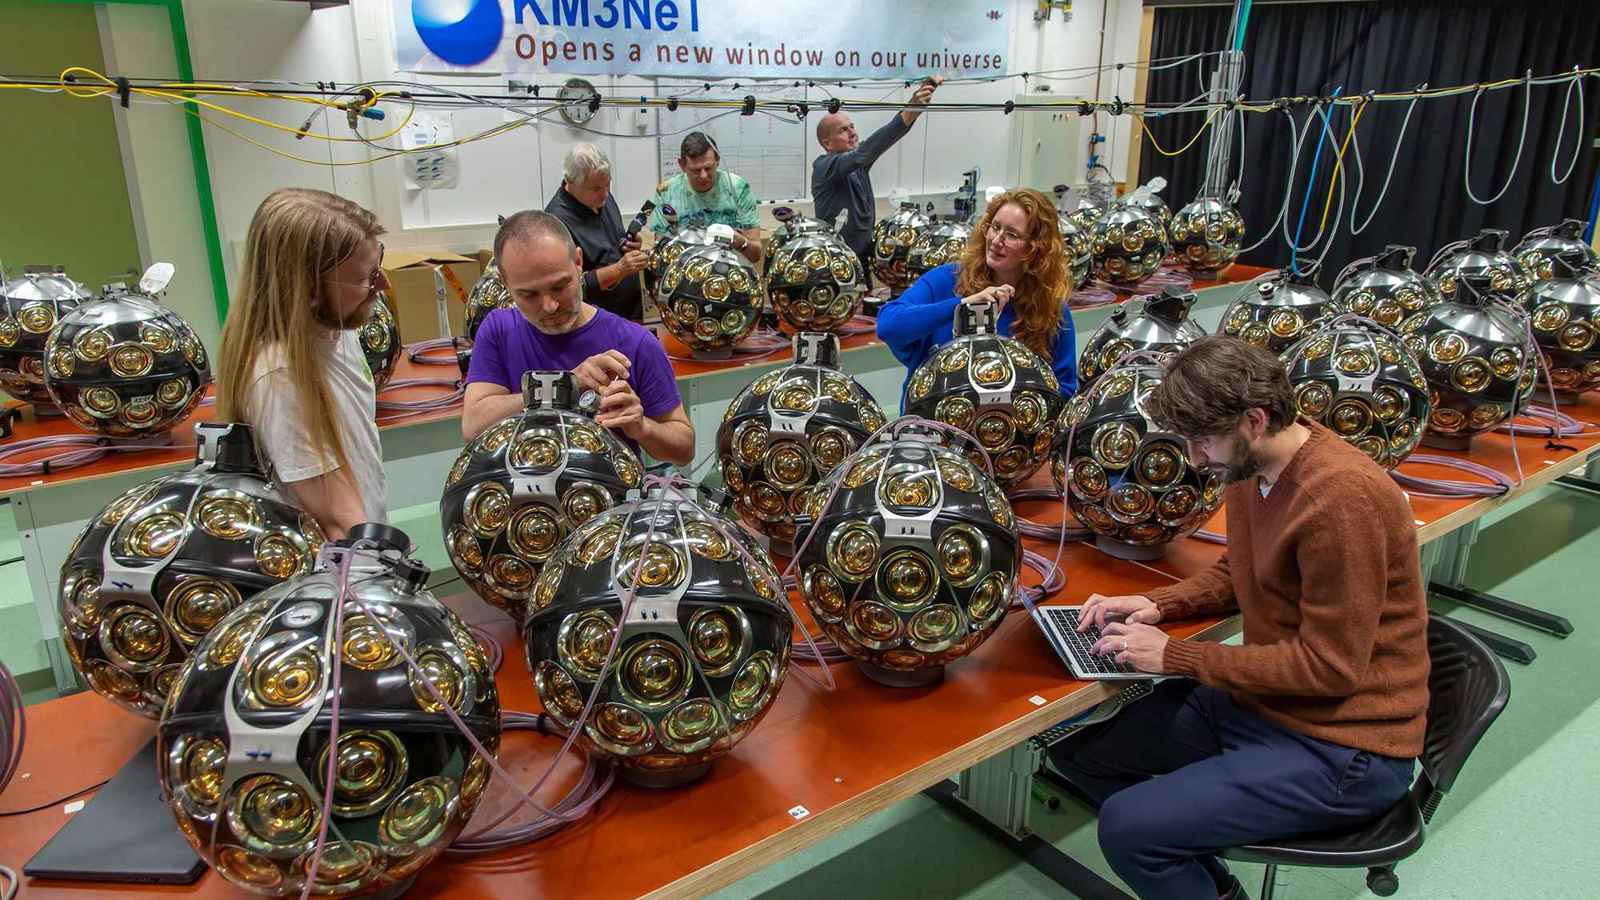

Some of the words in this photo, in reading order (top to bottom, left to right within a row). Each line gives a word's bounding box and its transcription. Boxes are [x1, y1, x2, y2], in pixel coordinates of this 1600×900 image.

[515, 33, 615, 65] Opens
[629, 43, 641, 62] a
[657, 44, 713, 64] new
[726, 42, 823, 66] window
[835, 50, 860, 67] on
[871, 50, 907, 68] our
[917, 48, 1002, 69] universe
